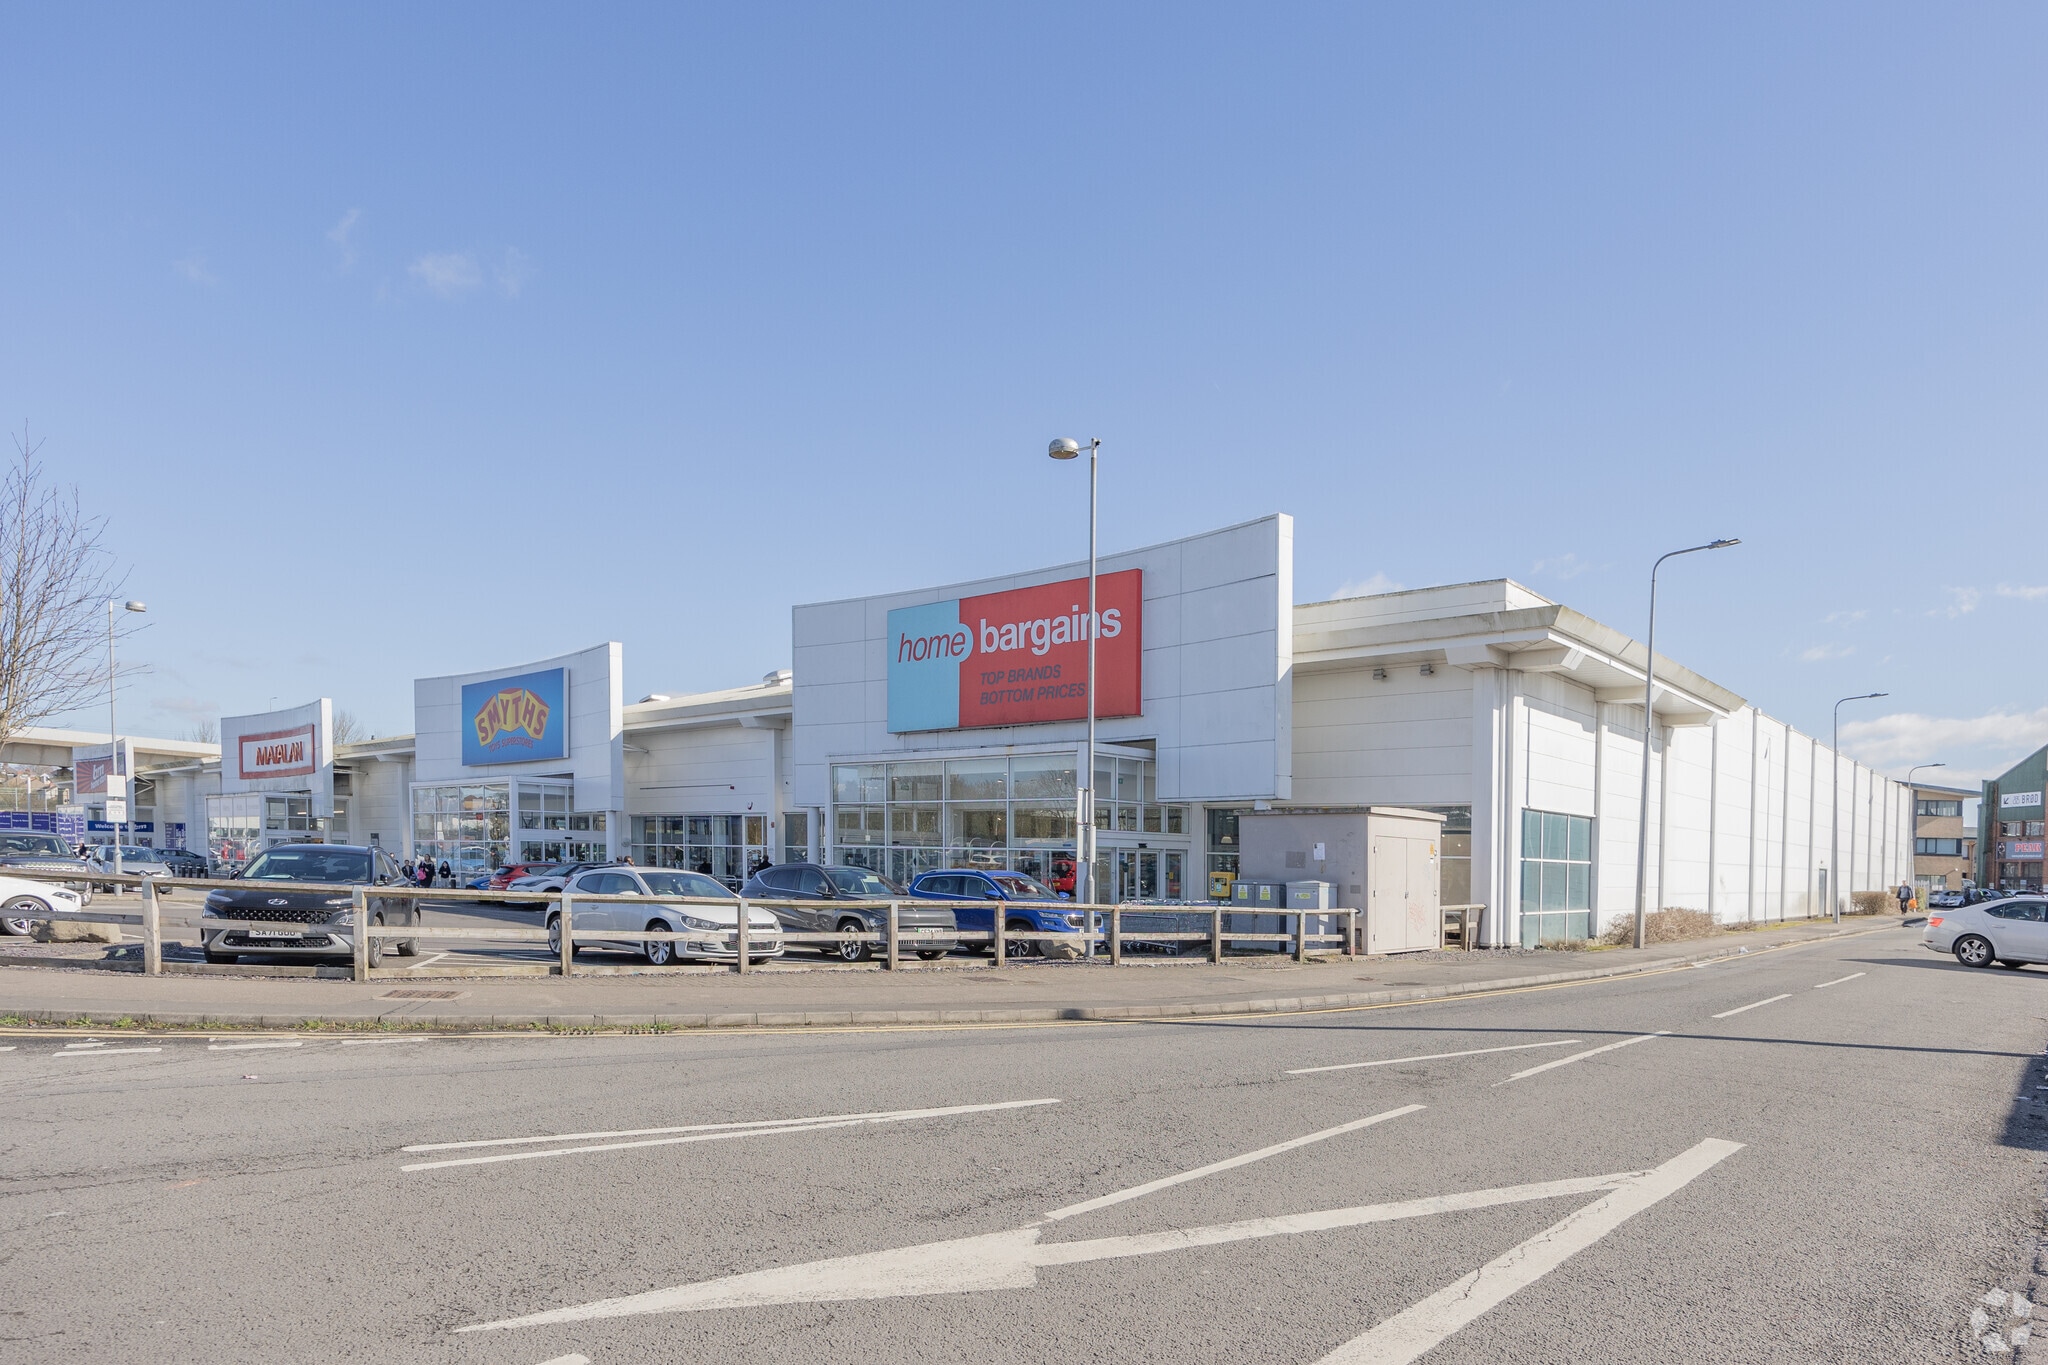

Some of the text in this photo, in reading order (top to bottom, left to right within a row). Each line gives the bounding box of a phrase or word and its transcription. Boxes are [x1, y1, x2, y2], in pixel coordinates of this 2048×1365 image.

[898, 604, 1122, 663] home bargains
[981, 664, 1062, 686] TOP BRANDS
[980, 682, 1086, 705] BOTTOM PRICES
[477, 695, 547, 742] SMYTHS
[256, 741, 303, 766] MATALAN
[2015, 843, 2042, 853] PEAK
